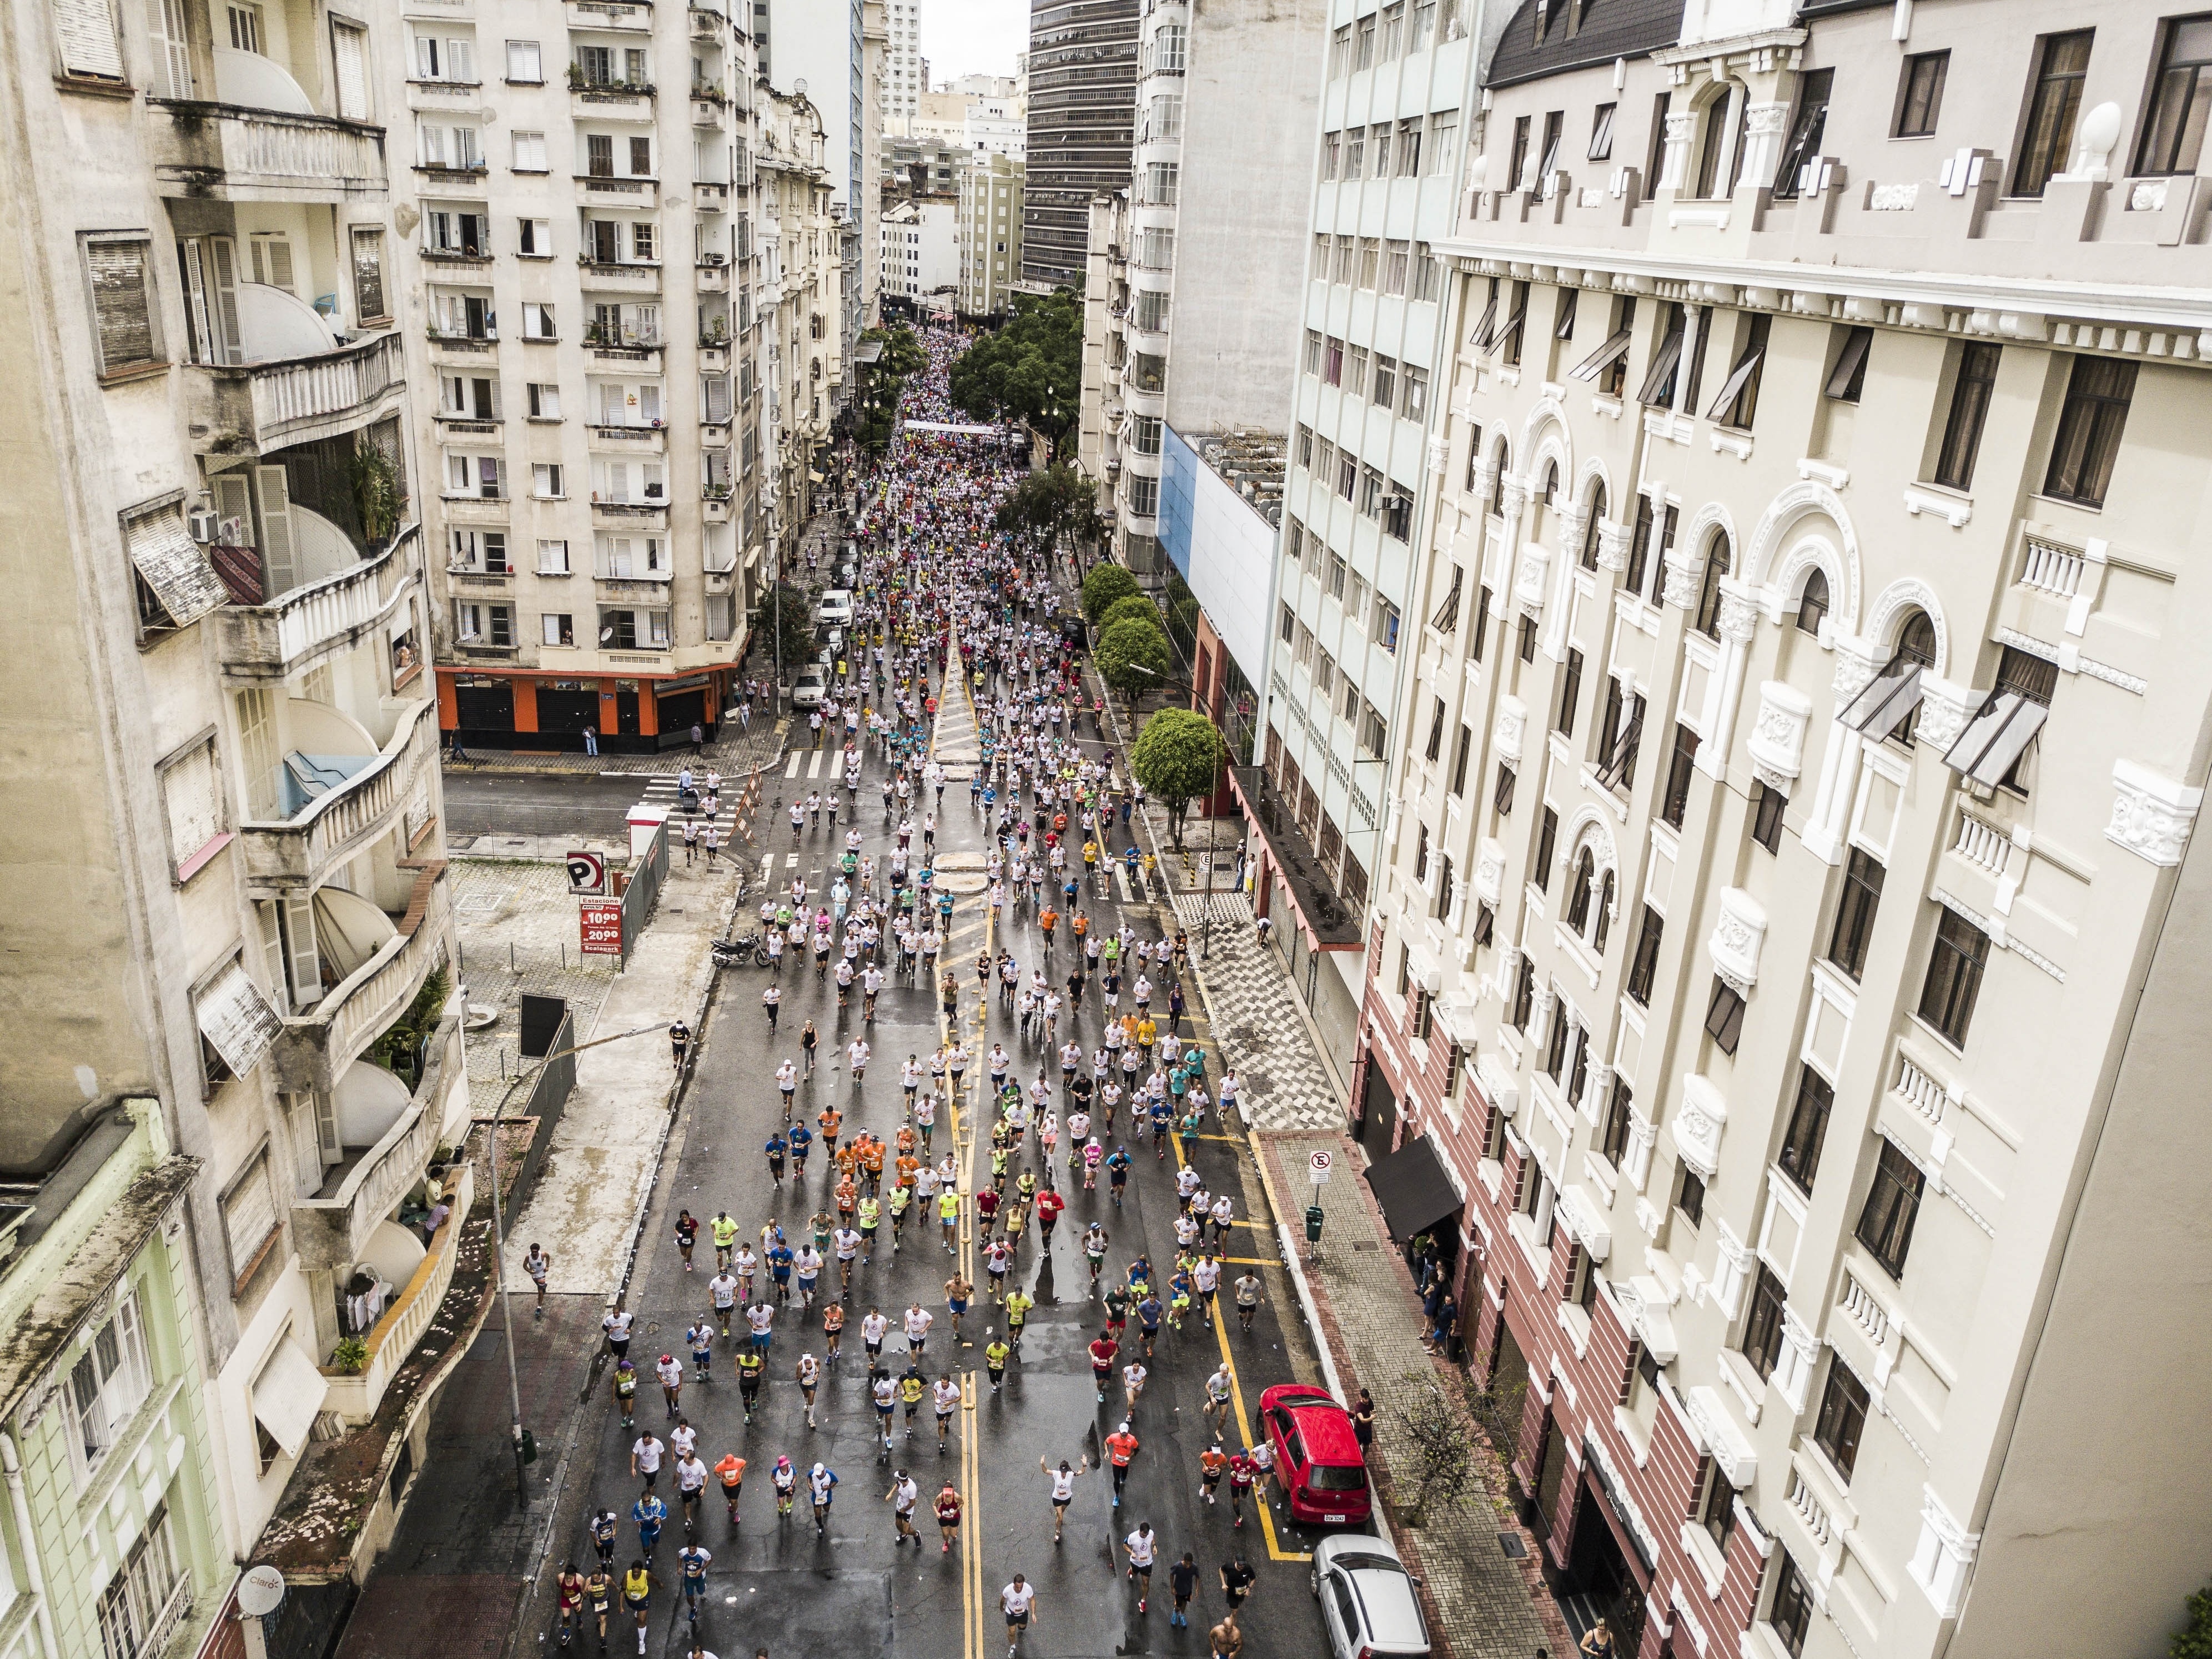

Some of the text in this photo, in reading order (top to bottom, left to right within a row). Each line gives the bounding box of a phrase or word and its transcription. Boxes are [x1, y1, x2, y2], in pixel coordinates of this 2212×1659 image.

[588, 912, 618, 924] 10,00
[589, 931, 619, 941] 20,00
[250, 1576, 274, 1589] Claro
